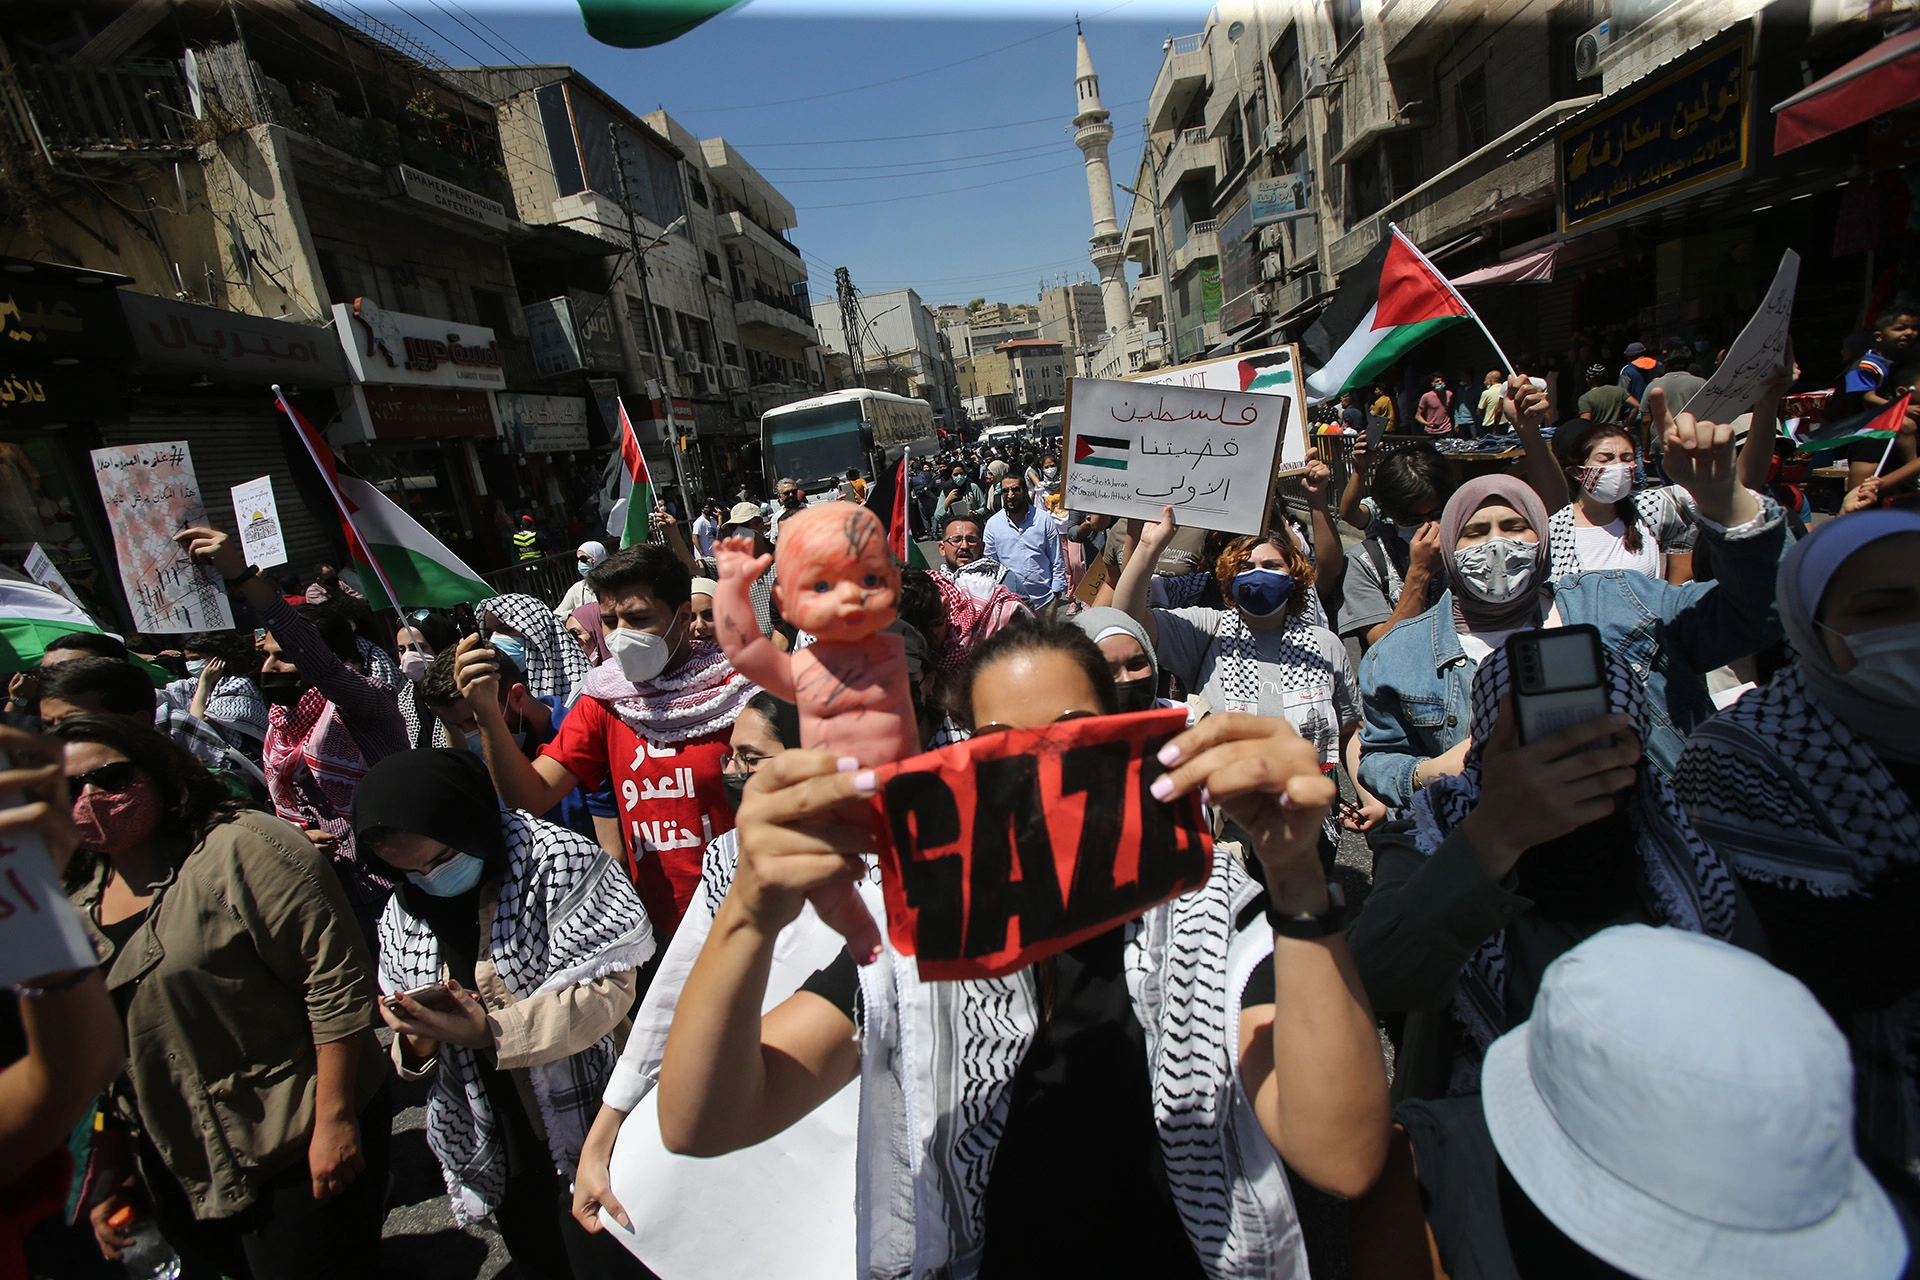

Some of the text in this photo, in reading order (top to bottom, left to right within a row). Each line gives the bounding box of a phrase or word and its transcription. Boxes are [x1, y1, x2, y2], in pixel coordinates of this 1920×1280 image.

[405, 169, 448, 194] SHAHER
[434, 194, 485, 221] CAFETERIA
[1111, 396, 1259, 426] فلسطين
[1140, 435, 1240, 470] قضيتنا
[621, 767, 696, 812] العدو
[628, 813, 713, 863] احتلال
[885, 732, 1207, 962] GAZA
